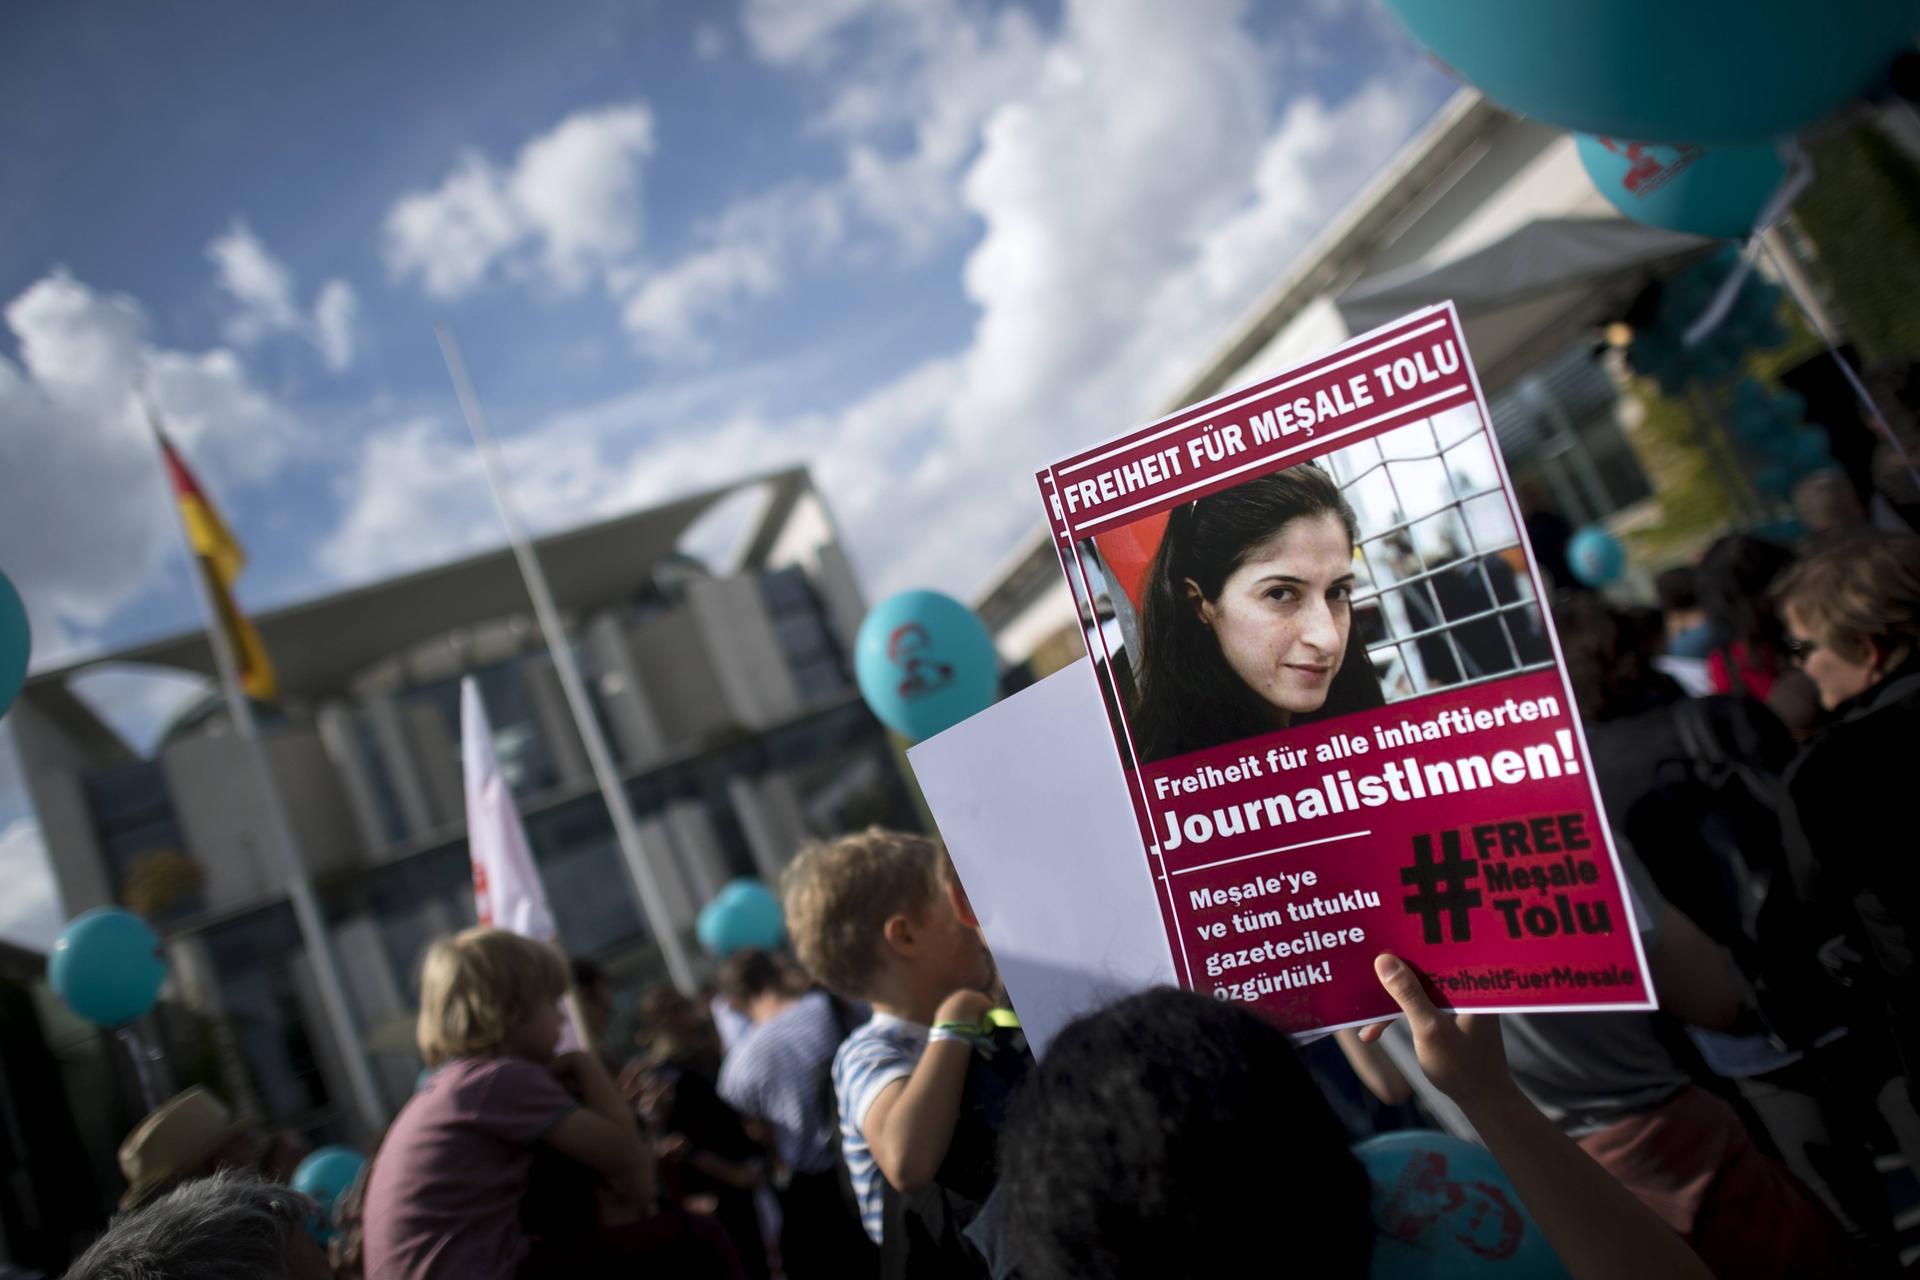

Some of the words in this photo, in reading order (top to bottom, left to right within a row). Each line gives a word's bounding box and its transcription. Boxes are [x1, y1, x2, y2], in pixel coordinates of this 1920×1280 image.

[1063, 446, 1182, 514] FREIHEIT
[1187, 411, 1247, 469] FÜR
[1249, 374, 1375, 446] MEŞALE
[1374, 340, 1459, 397] TOLU
[1154, 756, 1263, 800] Freiheit
[1266, 748, 1308, 774] für
[1316, 735, 1369, 763] alle
[1373, 696, 1560, 751] inhaftierten
[1163, 728, 1580, 850] JournalistInnen!
[1482, 855, 1599, 896] Meşale
[1197, 922, 1227, 941] ve
[1232, 909, 1283, 933] tüm
[1286, 889, 1381, 922] tutuklu
[1493, 895, 1613, 939] Tolu
[1205, 926, 1365, 977] gazetecilere
[1213, 961, 1333, 1002] özgürlük!
